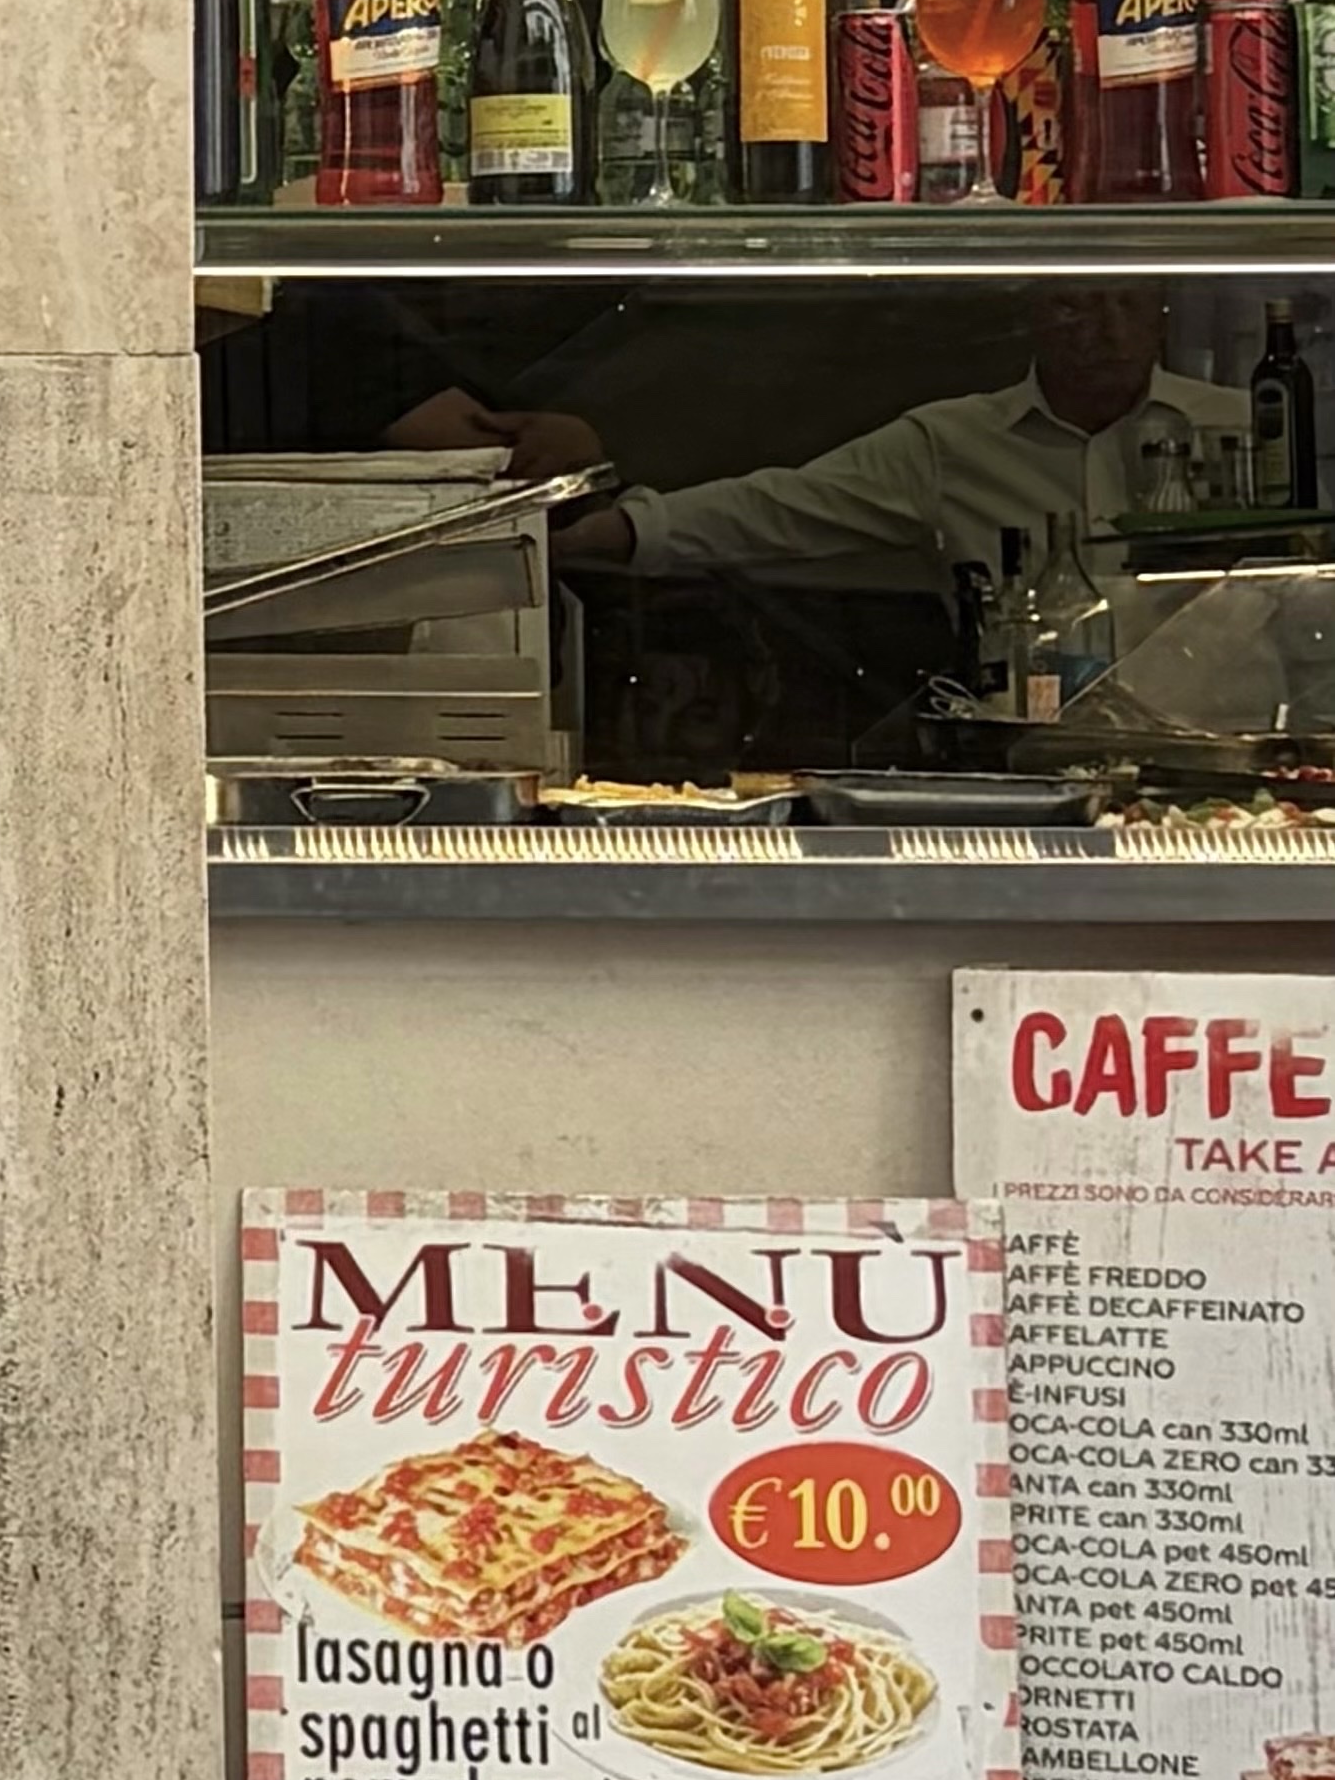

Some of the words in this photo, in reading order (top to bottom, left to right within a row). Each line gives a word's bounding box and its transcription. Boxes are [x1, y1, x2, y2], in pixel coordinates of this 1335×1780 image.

[1174, 1137, 1303, 1174] TAKE
[1004, 1181, 1080, 1202] PREZZI
[1084, 1184, 1149, 1204] SONO
[1155, 1187, 1185, 1204] DA
[1008, 1229, 1081, 1257] AFFÈ
[1008, 1261, 1082, 1287] AFFÈ
[1088, 1266, 1208, 1291] FREDDO
[1008, 1291, 1082, 1317] AFFÈ
[1088, 1296, 1305, 1324] DECAFFEINATO
[1008, 1324, 1169, 1349] AFFELATTE
[312, 1314, 934, 1436] turistico
[1008, 1353, 1176, 1380] APPUCCINO
[1007, 1377, 1126, 1408] È-INFUSI
[1008, 1412, 1155, 1439] OCA-COLA
[1162, 1424, 1212, 1441] can
[1218, 1420, 1310, 1446] 330ml
[1008, 1442, 1156, 1469] OCA-COLA
[1162, 1449, 1241, 1473] ZERO
[1248, 1456, 1299, 1475] can
[1009, 1473, 1081, 1496] ANTA
[1088, 1479, 1136, 1499] can
[1144, 1478, 1234, 1503] 330ml
[1010, 1504, 1091, 1527] PRITE
[1098, 1510, 1147, 1530] can
[1154, 1509, 1244, 1535] 330ml
[1011, 1533, 1157, 1560] OCA-COLA
[1163, 1543, 1211, 1565] pet
[1218, 1543, 1310, 1568] 450ml
[1012, 1563, 1157, 1590] OCA-COLA
[1164, 1571, 1243, 1595] ZERO
[1250, 1577, 1298, 1600] pet
[1089, 1599, 1136, 1623] pet
[1143, 1601, 1233, 1625] 450ml
[1015, 1624, 1092, 1649] PRITE
[1099, 1631, 1147, 1653] pet
[1153, 1632, 1244, 1657] 450ml
[297, 1618, 503, 1700] lasagna
[526, 1642, 555, 1689] o
[1018, 1655, 1175, 1684] OCCOLATO
[1182, 1663, 1284, 1690] CALDO
[1017, 1686, 1136, 1713] ORNETTI
[299, 1698, 549, 1776] spaghetti
[571, 1702, 601, 1741] al
[1019, 1717, 1140, 1742] ROSTATA
[1021, 1746, 1200, 1777] AMBELLONE
